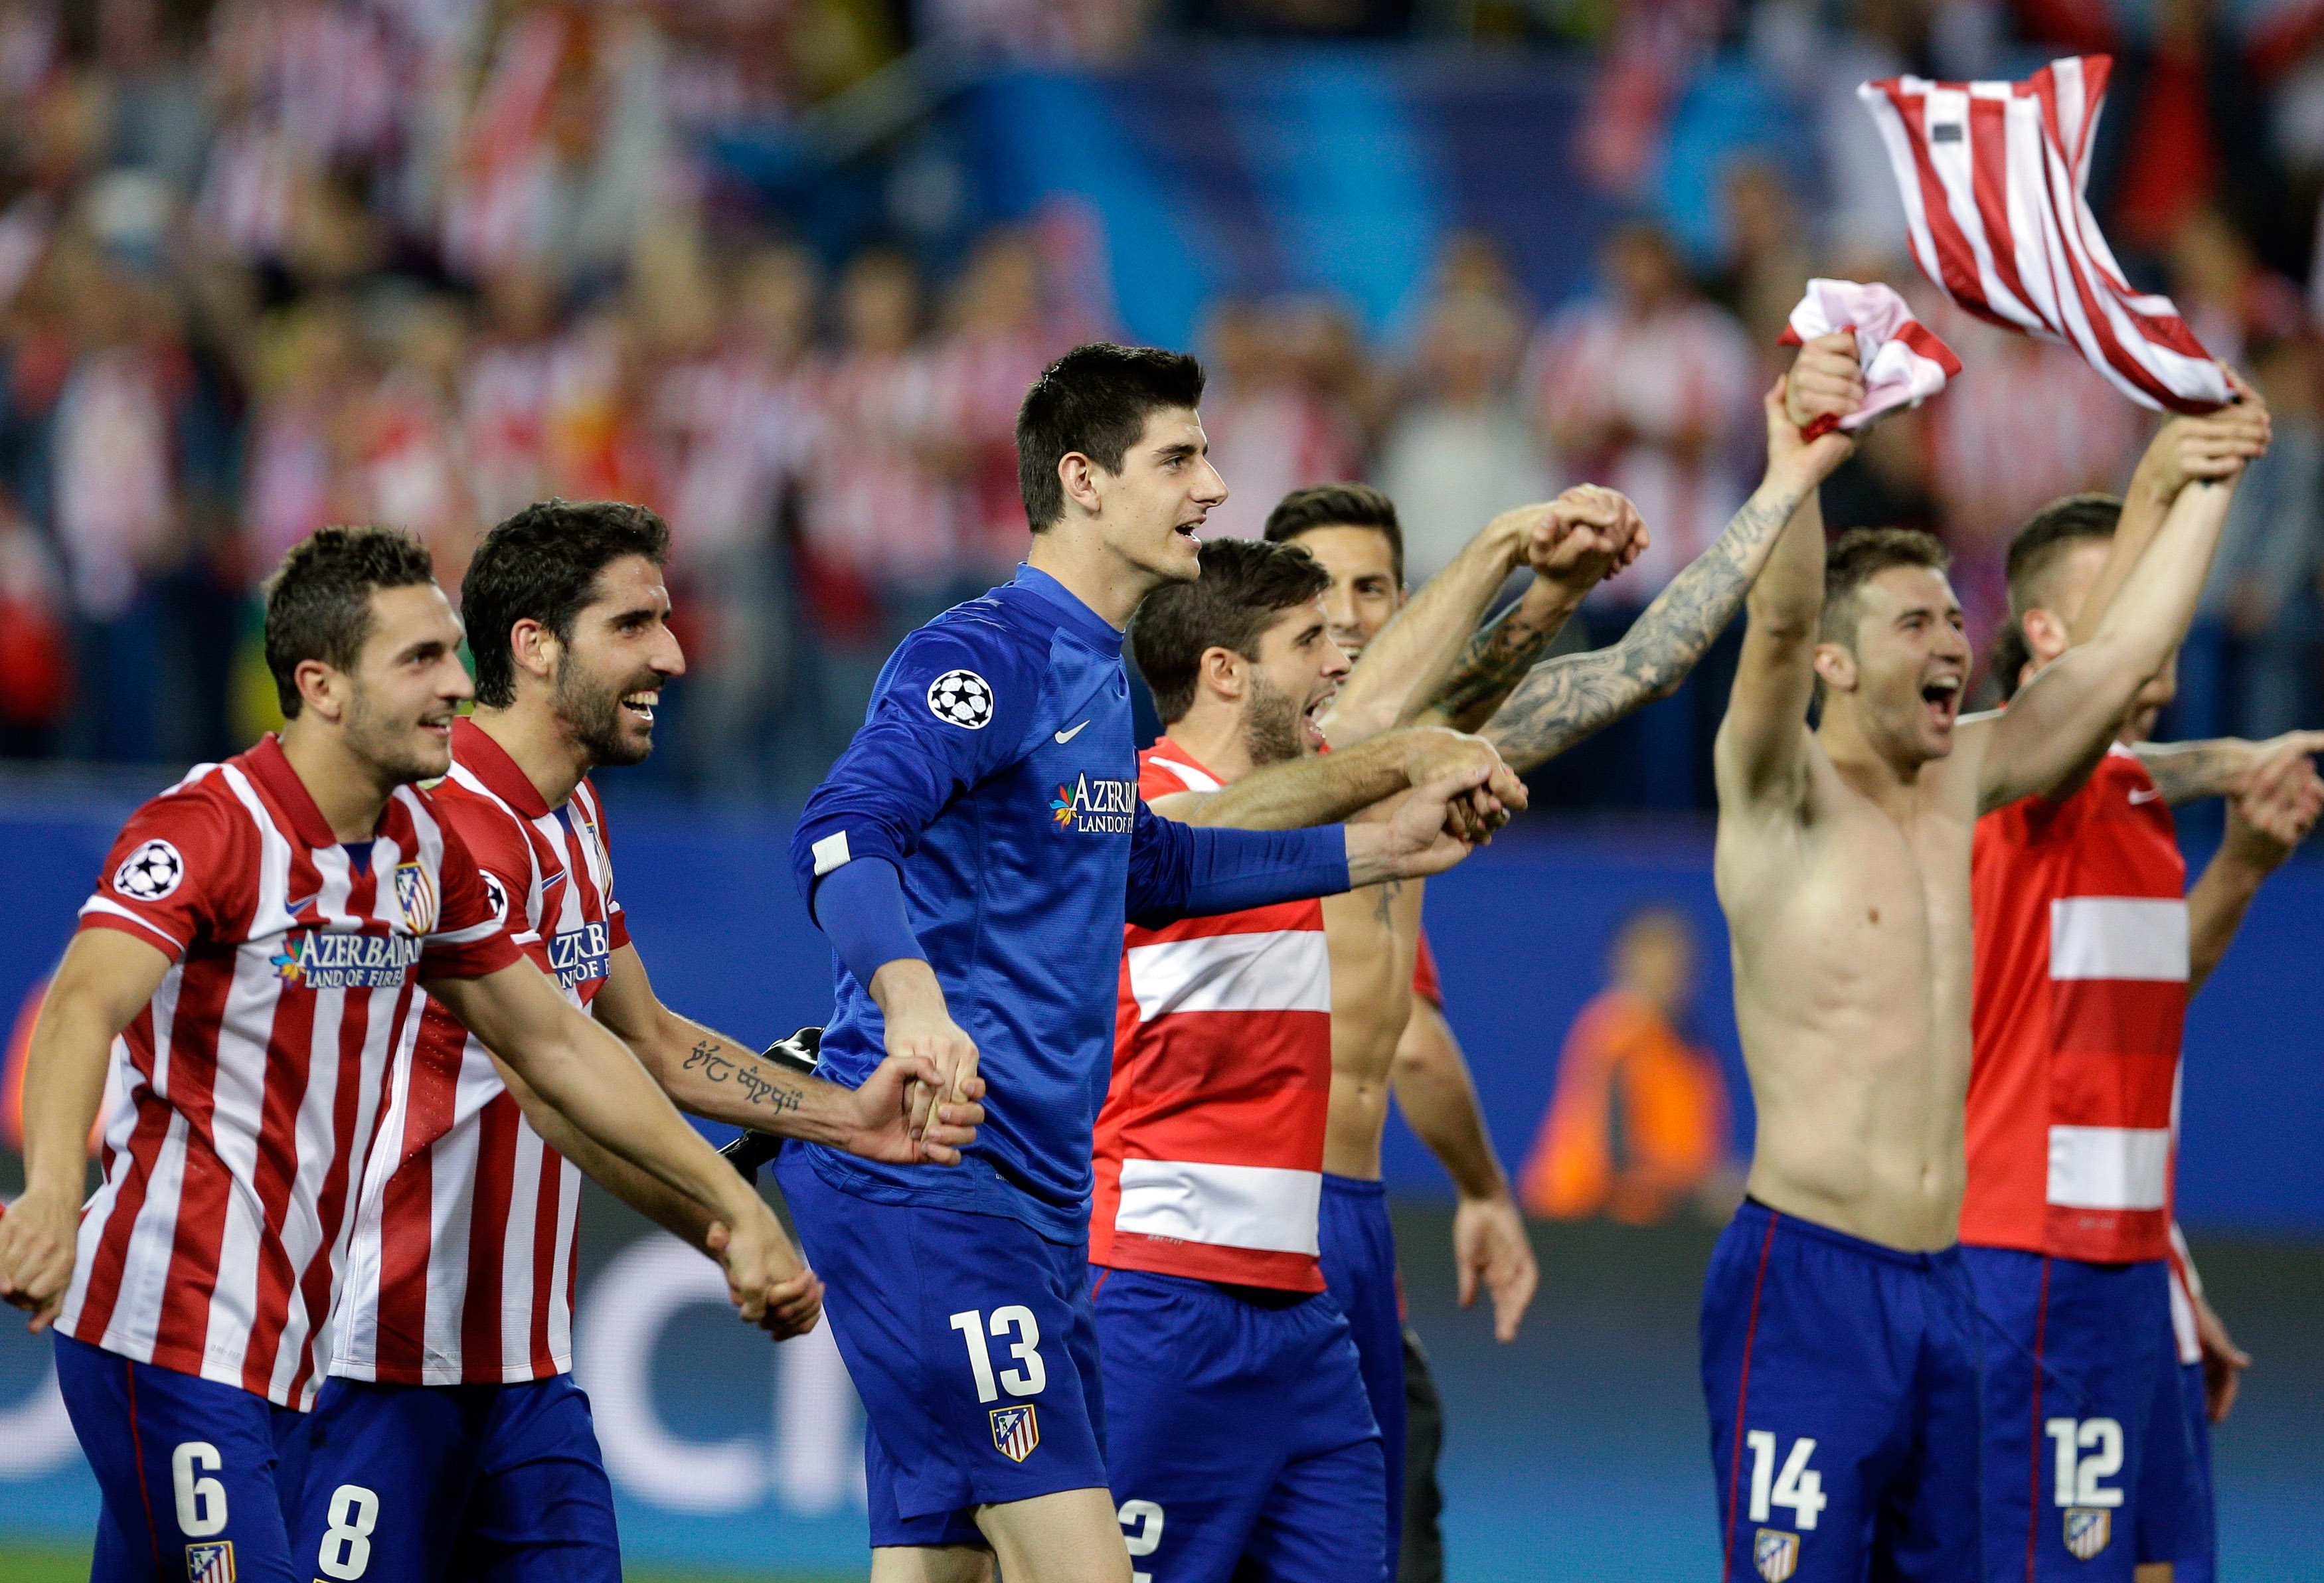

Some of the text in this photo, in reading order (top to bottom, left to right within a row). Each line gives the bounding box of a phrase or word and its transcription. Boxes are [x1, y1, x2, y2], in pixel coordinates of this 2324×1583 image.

[1078, 815, 1114, 832] LAND
[1115, 816, 1127, 833] OF
[305, 968, 345, 988] LAND
[345, 969, 365, 987] OF
[575, 960, 598, 981] OF
[950, 1305, 1046, 1403] 13
[172, 1441, 228, 1537] 6
[1747, 1430, 1827, 1530] 14
[2045, 1418, 2124, 1507] 12
[319, 1484, 379, 1582] 8
